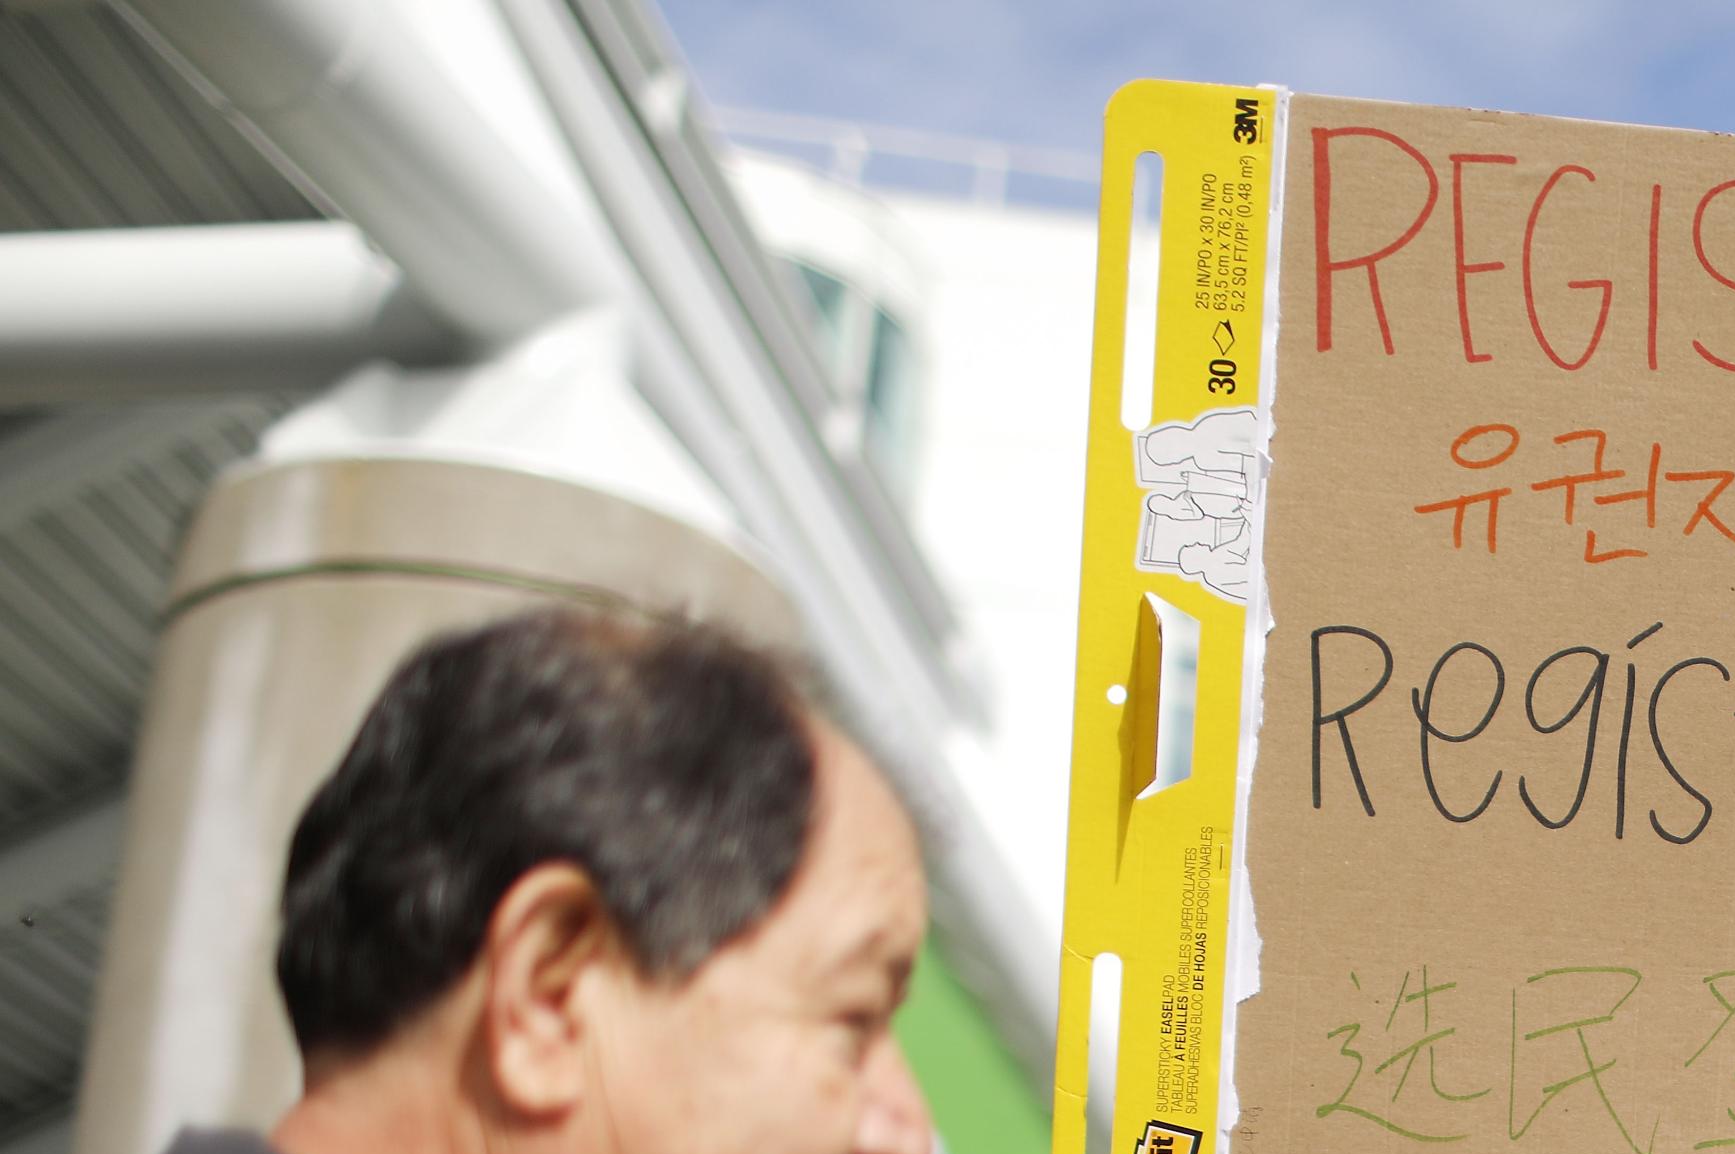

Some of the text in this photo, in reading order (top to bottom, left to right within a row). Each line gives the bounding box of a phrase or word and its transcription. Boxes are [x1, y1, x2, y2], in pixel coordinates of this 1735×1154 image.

[1233, 98, 1259, 145] 3M
[1200, 173, 1217, 212] IN/PO
[1222, 183, 1234, 204] cm
[1200, 215, 1215, 234] 30
[1217, 207, 1234, 238] 76,2
[1196, 250, 1213, 288] IN/PO
[1218, 255, 1230, 276] cm
[1231, 266, 1247, 286] SQ
[1195, 291, 1211, 310] 25
[1213, 280, 1230, 311] 63,5
[1231, 291, 1246, 312] 5.2
[1208, 359, 1237, 395] 30
[1177, 943, 1192, 993] MOBILES
[1186, 825, 1214, 1114] SUPERADHESIVAS BLOC DE HOJAS REPOSICIONABLES
[1174, 995, 1189, 1051] FEUILLES
[1156, 1036, 1172, 1113] SUPERSTICKY
[1171, 1063, 1186, 1114] TABLEAU
